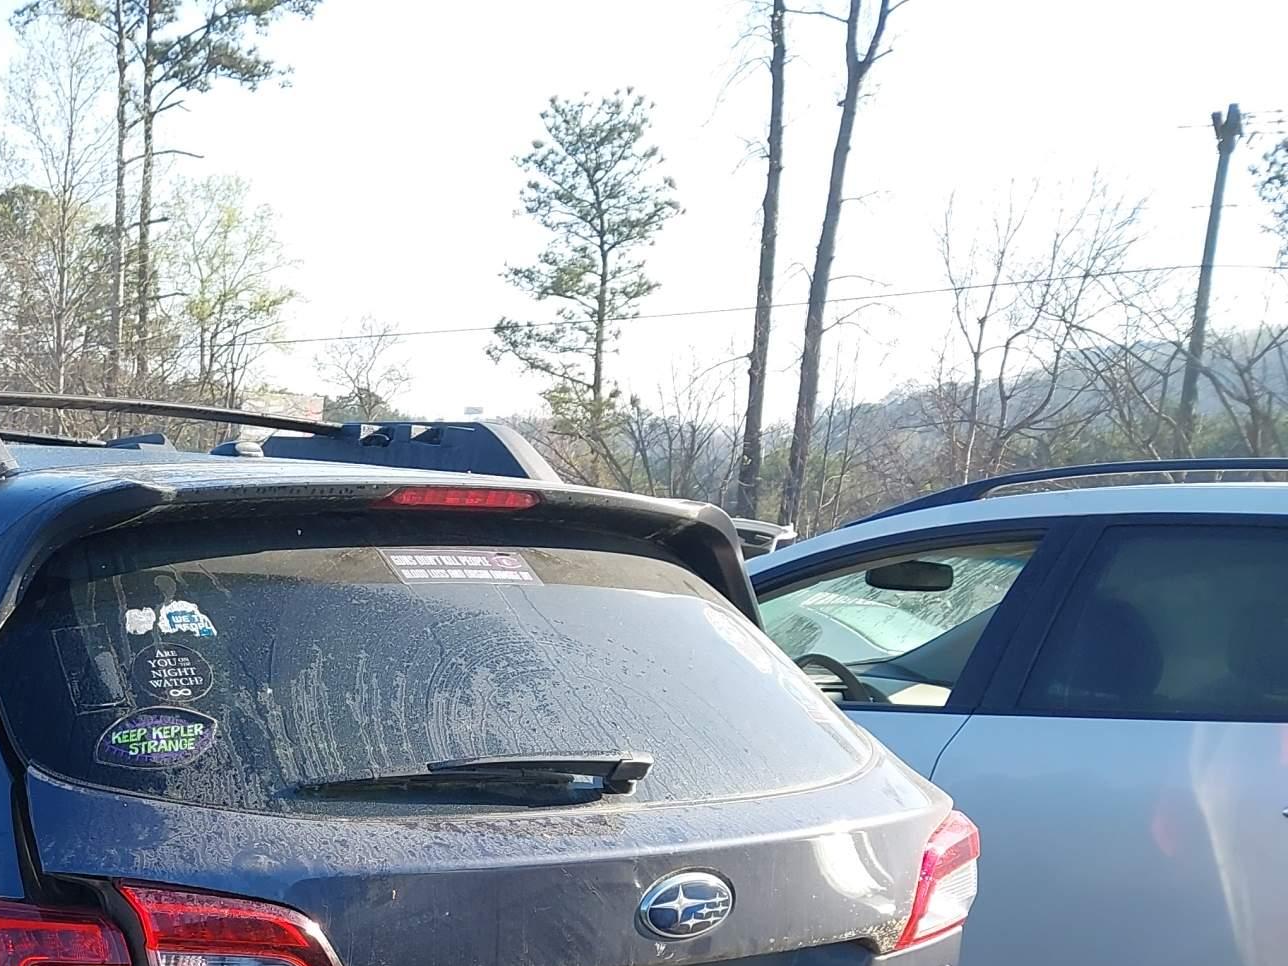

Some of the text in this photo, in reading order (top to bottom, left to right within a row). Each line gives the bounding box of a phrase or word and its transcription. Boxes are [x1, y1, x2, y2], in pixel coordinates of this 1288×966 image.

[147, 657, 177, 668] YOU
[151, 667, 197, 678] NIGHT
[149, 677, 204, 688] WATCH?
[112, 723, 204, 745] KEEP KEPLER
[128, 738, 196, 756] STRANGE
